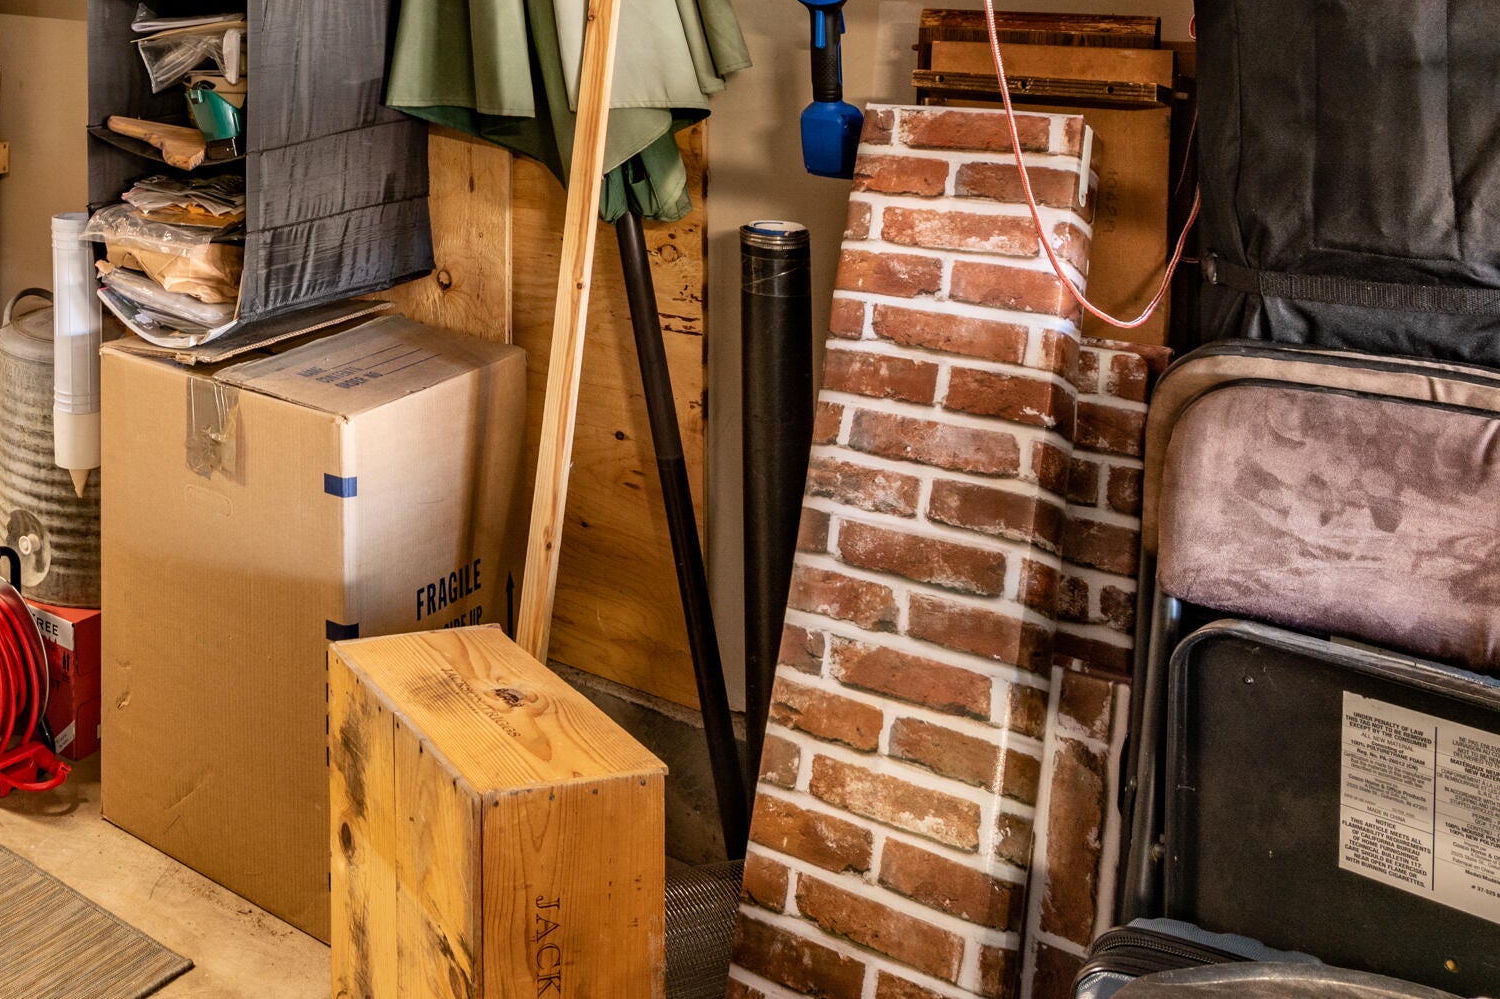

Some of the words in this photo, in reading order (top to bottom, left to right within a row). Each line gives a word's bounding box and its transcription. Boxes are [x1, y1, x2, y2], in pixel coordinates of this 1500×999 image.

[416, 558, 482, 621] FRAGILE
[32, 613, 60, 637] REE
[1345, 715, 1358, 723] THIS
[1360, 719, 1371, 727] TAG
[1372, 722, 1384, 730] NOT
[1403, 731, 1432, 744] REMOVED
[1349, 722, 1371, 731] EXCEPT
[1394, 734, 1427, 748] CONSUMER
[1353, 712, 1373, 722] UNDER
[1374, 717, 1400, 729] PENALTY
[1410, 728, 1424, 737] LAW
[1386, 739, 1413, 752] MATERIAL
[1409, 757, 1425, 765] FOAM
[1465, 767, 1479, 776] NEW
[1367, 806, 1381, 814] MADE
[1389, 813, 1406, 823] CHINA
[1375, 818, 1397, 829] NOTICE
[1341, 820, 1385, 838] FLAMMABILITY
[1385, 834, 1431, 854] REQUIREMENTS
[1350, 817, 1363, 825] THIS
[1365, 821, 1388, 834] ARTICLE
[1389, 830, 1410, 841] MEETS
[1411, 837, 1422, 845] ALL
[1349, 839, 1380, 854] TECHNICAL
[1381, 851, 1410, 864] BULLETIN
[1360, 832, 1395, 847] CALIFORNIA
[1396, 844, 1420, 856] BUREAU
[1361, 838, 1378, 847] HOME
[1379, 845, 1419, 862] FURNISHINGS
[1344, 844, 1359, 852] CARE
[1361, 849, 1384, 861] SHOULD
[1394, 861, 1427, 876] EXERCISED
[1345, 856, 1360, 865] WITH
[1361, 861, 1387, 874] BURNING
[1388, 870, 1426, 888] CIGARETTES.
[1353, 853, 1370, 862] NEAR
[1370, 859, 1386, 867] OPEN
[1387, 865, 1407, 875] FLAME
[535, 895, 561, 998] JACK
